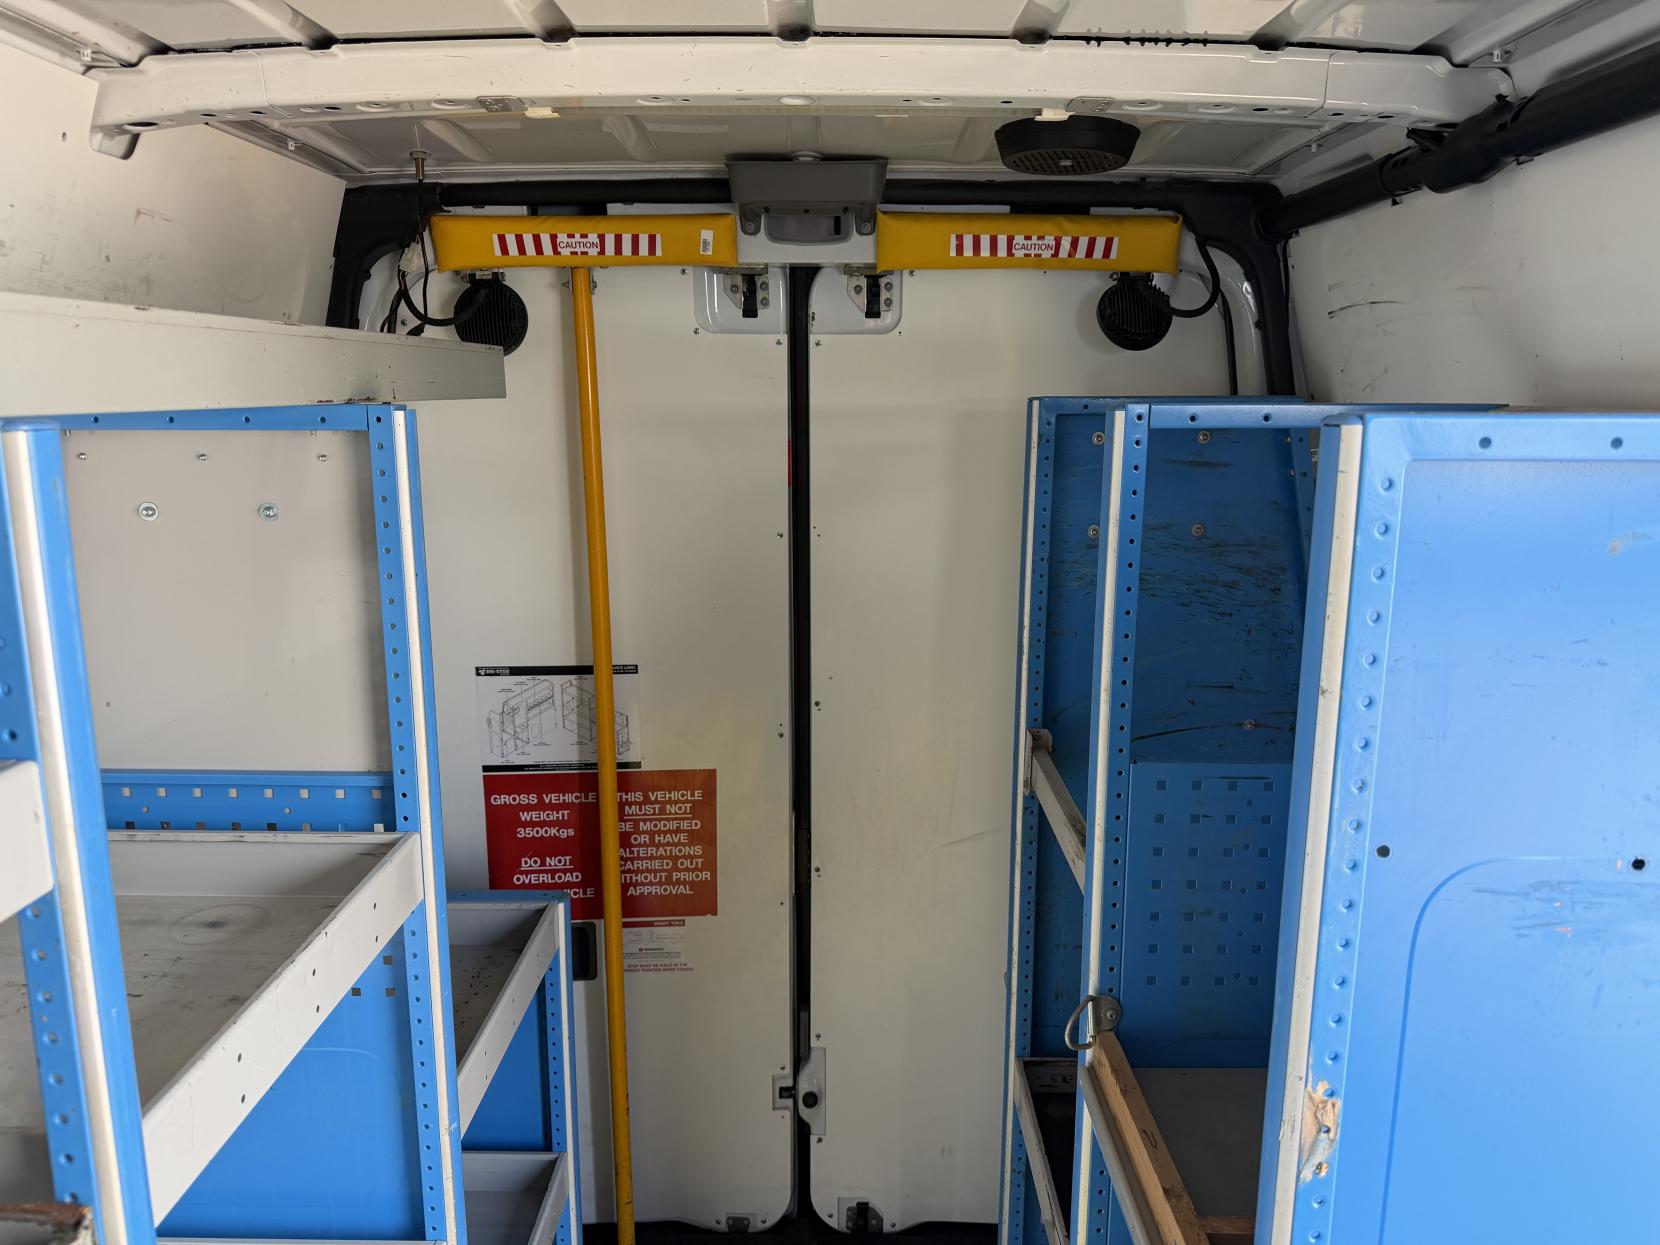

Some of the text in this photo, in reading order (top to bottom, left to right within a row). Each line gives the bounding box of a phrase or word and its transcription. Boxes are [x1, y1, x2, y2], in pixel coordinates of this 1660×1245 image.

[558, 240, 599, 249] CAUTION
[1013, 242, 1055, 251] CAUTION
[490, 792, 597, 805] GROSS VEHICLE
[648, 790, 703, 801] VEHICLE
[624, 803, 693, 815] MUST NOT
[519, 810, 570, 822] WEIGHT
[639, 819, 701, 831] MODIFIED
[516, 826, 575, 838] 3500Kgs
[630, 833, 689, 845] OR HAVE
[521, 856, 572, 868] DO NOT
[677, 858, 704, 869] OUT
[513, 872, 582, 885] OVERLOAD
[621, 871, 711, 884] ITHOUT PRIOR
[626, 884, 694, 897] APPROVAL
